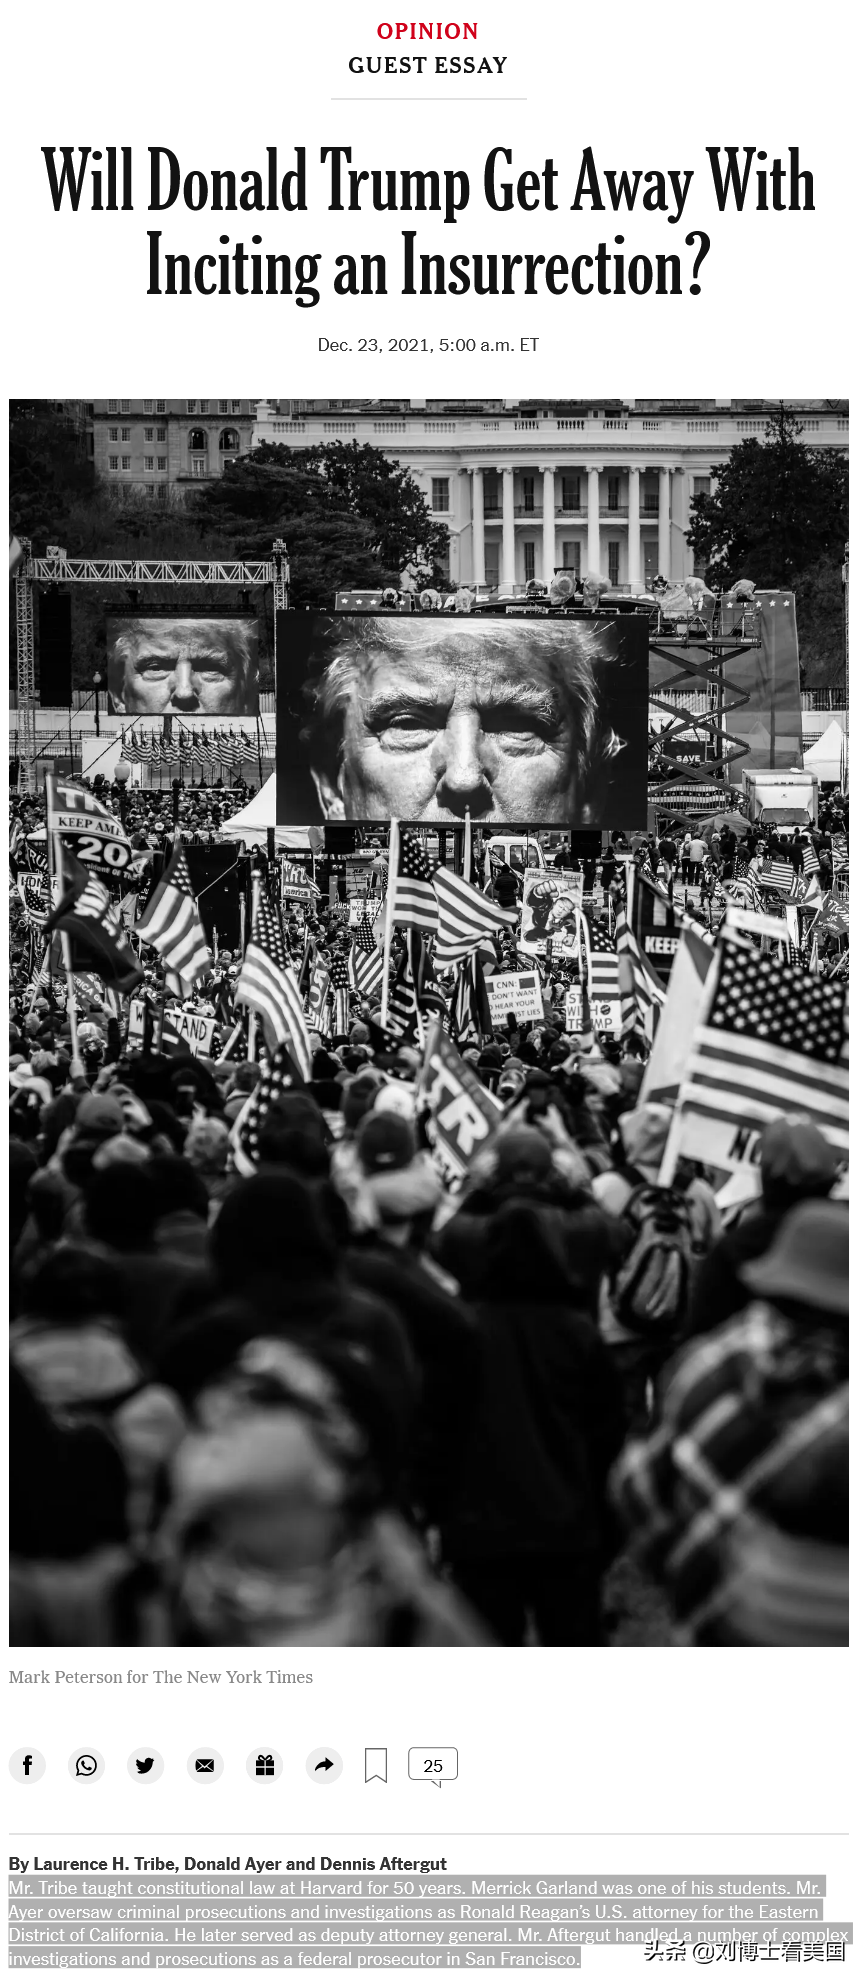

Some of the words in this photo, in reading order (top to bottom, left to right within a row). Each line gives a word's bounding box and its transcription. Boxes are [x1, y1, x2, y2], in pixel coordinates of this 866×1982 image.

[58, 816, 93, 829] KEEP
[77, 836, 128, 867] 20
[496, 980, 518, 989] CNN:
[492, 991, 514, 1000] DON'T
[516, 989, 538, 998] WANT
[495, 1002, 514, 1010] HEAR
[515, 999, 535, 1007] YOUR
[527, 1008, 541, 1016] LIES
[567, 1005, 598, 1016] WIH
[165, 1011, 207, 1042] TAND
